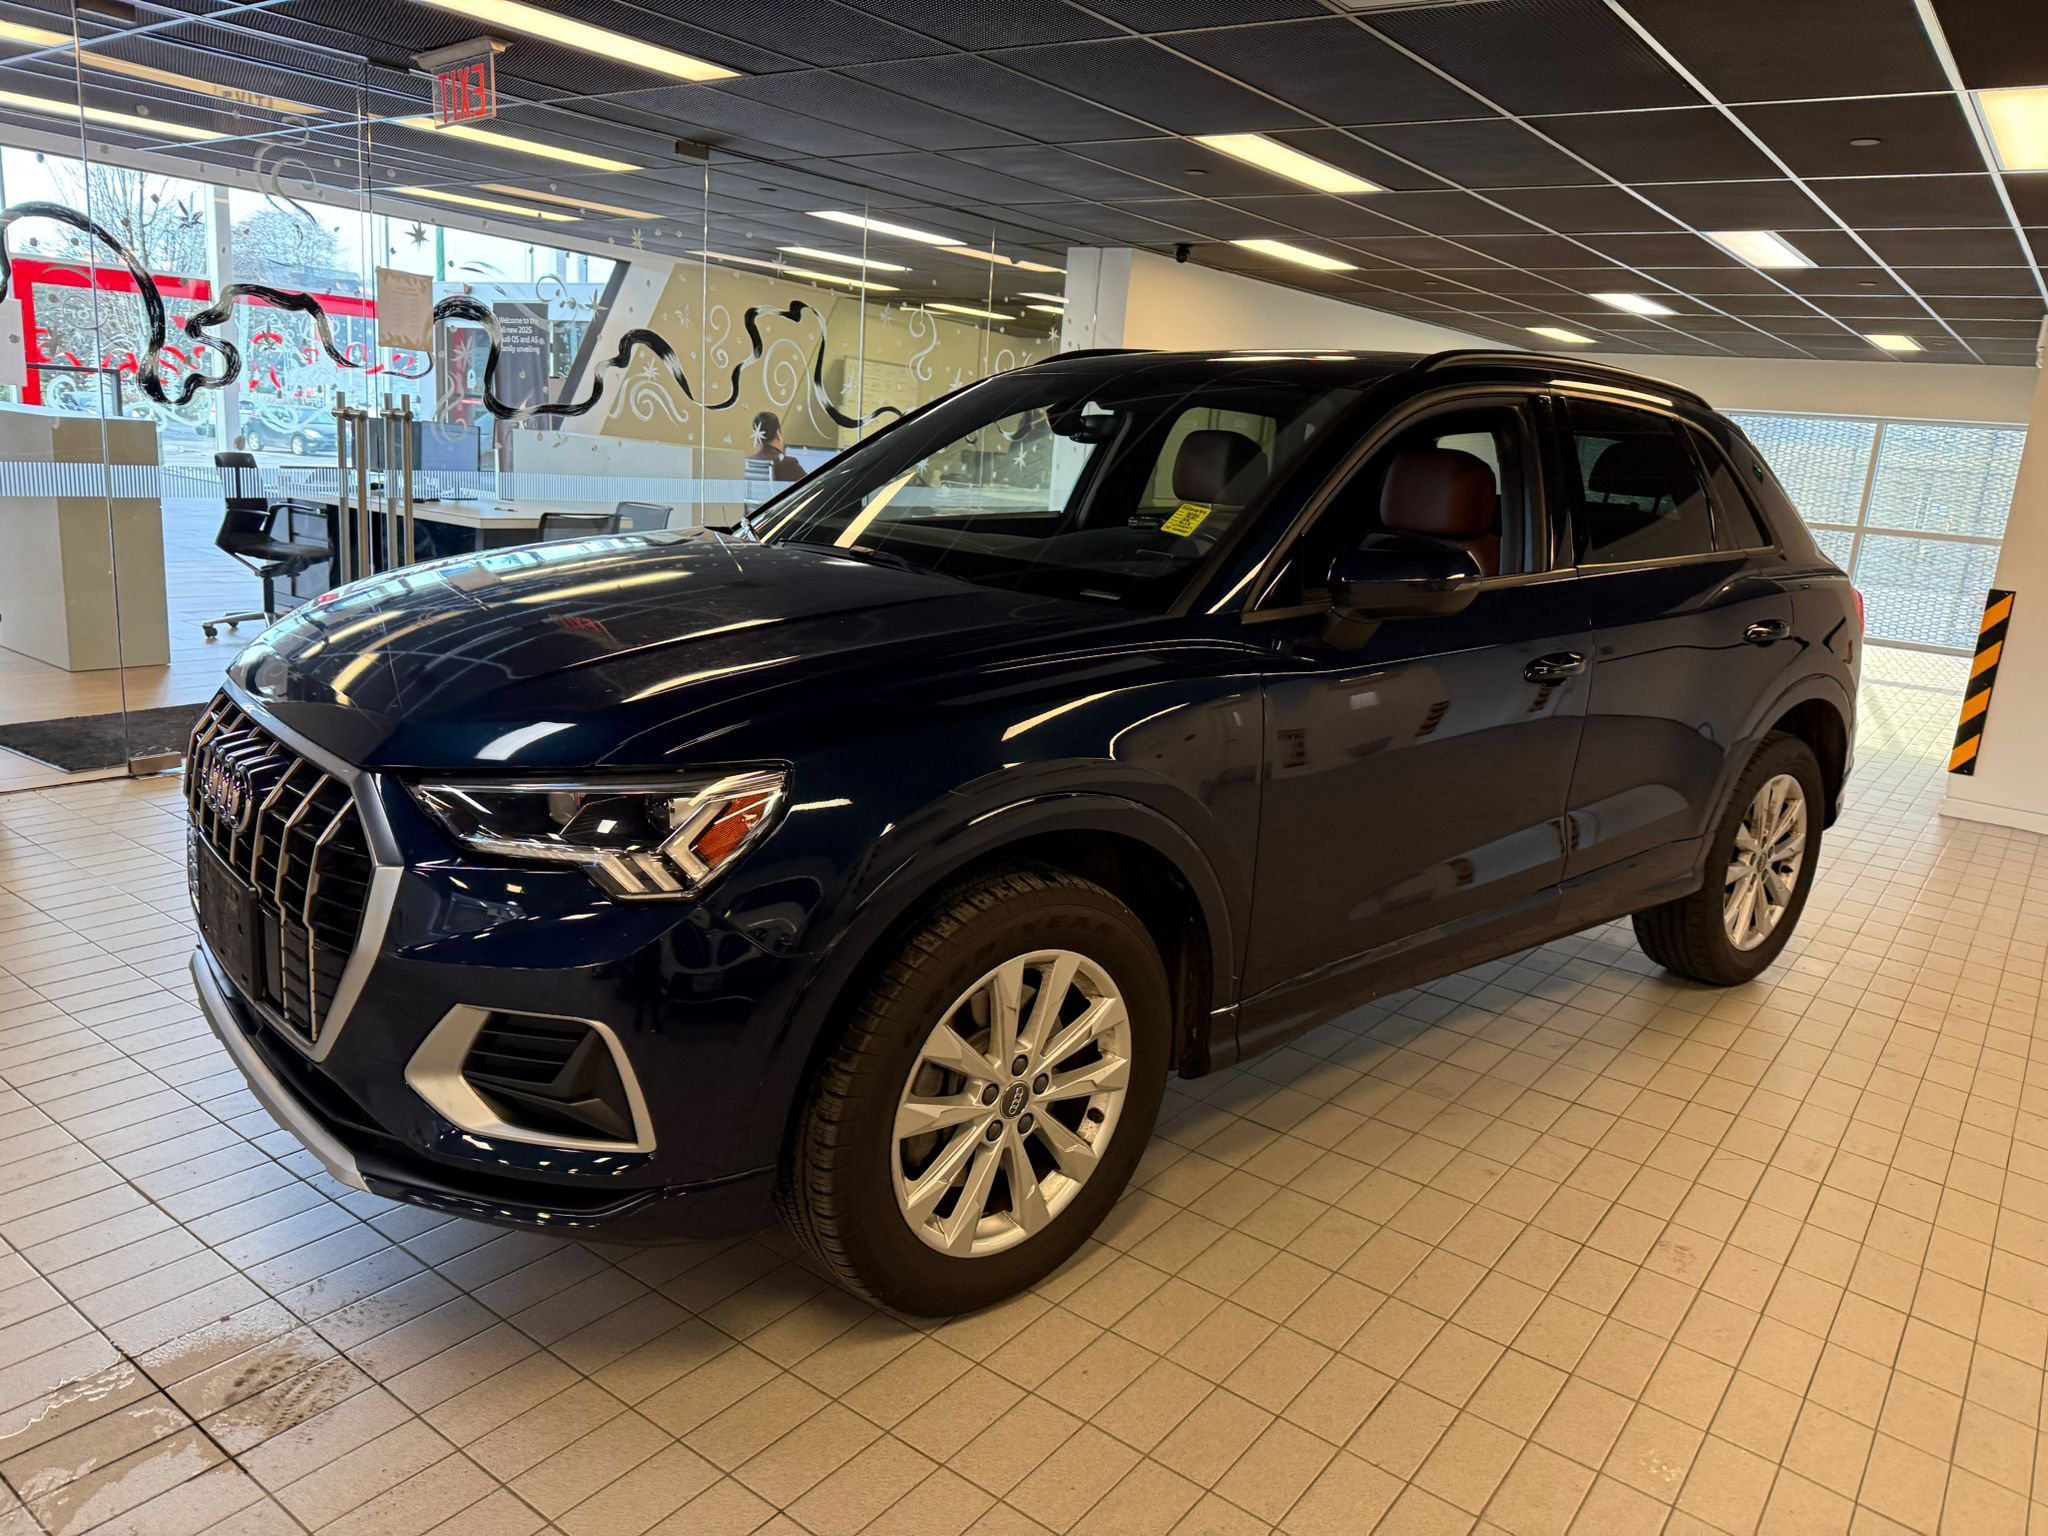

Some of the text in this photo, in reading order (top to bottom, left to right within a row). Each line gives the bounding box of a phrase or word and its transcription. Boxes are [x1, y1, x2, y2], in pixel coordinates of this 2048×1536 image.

[499, 316, 522, 324] Welcome
[518, 326, 532, 334] 2025
[511, 335, 519, 343] Q5
[531, 336, 539, 344] A5
[516, 346, 540, 355] unveiling
